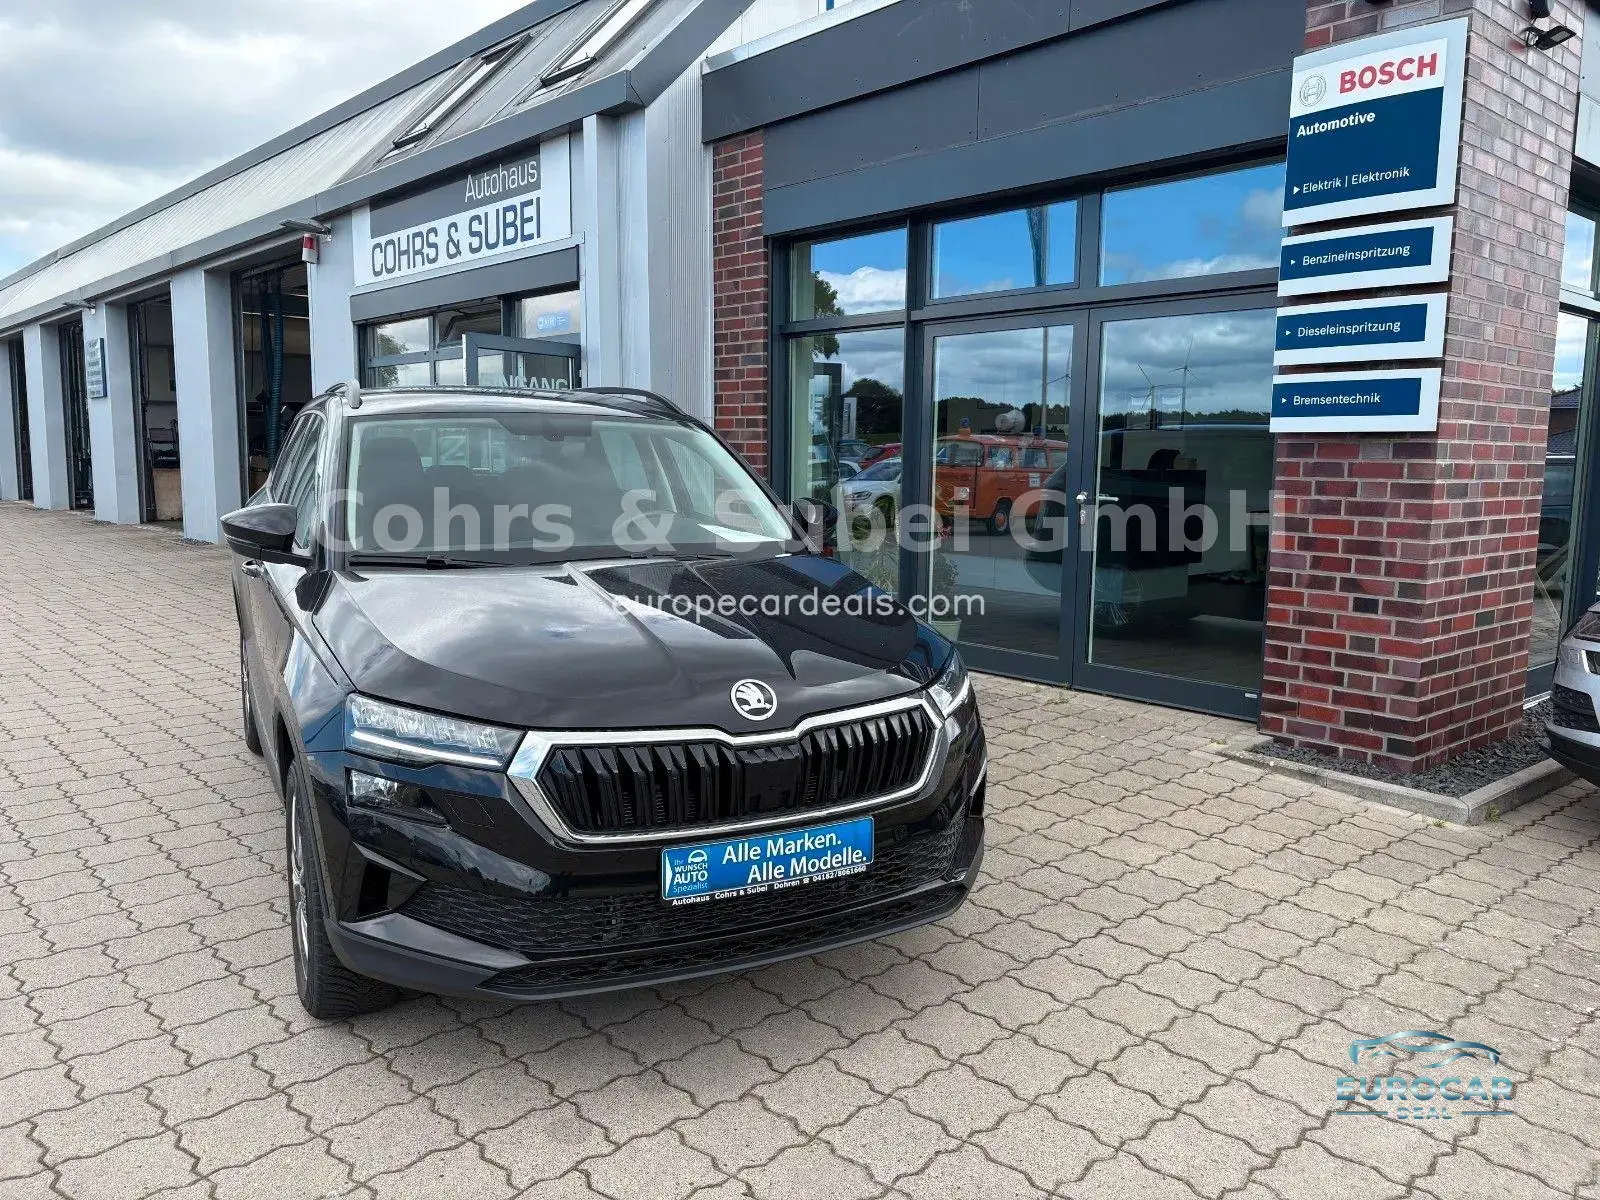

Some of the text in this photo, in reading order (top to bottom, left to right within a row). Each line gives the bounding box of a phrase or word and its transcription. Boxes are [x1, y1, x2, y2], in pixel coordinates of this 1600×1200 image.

[1340, 53, 1437, 94] BOSCH
[1297, 111, 1376, 137] Automotive
[464, 160, 538, 203] Autohaus
[1302, 177, 1342, 193] Elektrik
[1351, 166, 1410, 185] Elektronik
[372, 197, 541, 277] COHRS & SUBEI
[1302, 245, 1411, 266] Benzineinspritzung
[1297, 321, 1401, 337] Dieseleinspritzung
[1293, 393, 1381, 405] Bremsentechnik
[722, 832, 842, 865] Alle Marken.
[673, 870, 708, 885] AUTO
[674, 862, 708, 873] WUNSCH
[747, 846, 867, 883] Alle Modelle.
[672, 895, 710, 906] Autohaus
[715, 890, 738, 900] Cohrs
[747, 884, 768, 894] Subei
[774, 880, 800, 890] Dohren
[673, 882, 708, 894] Spezialist
